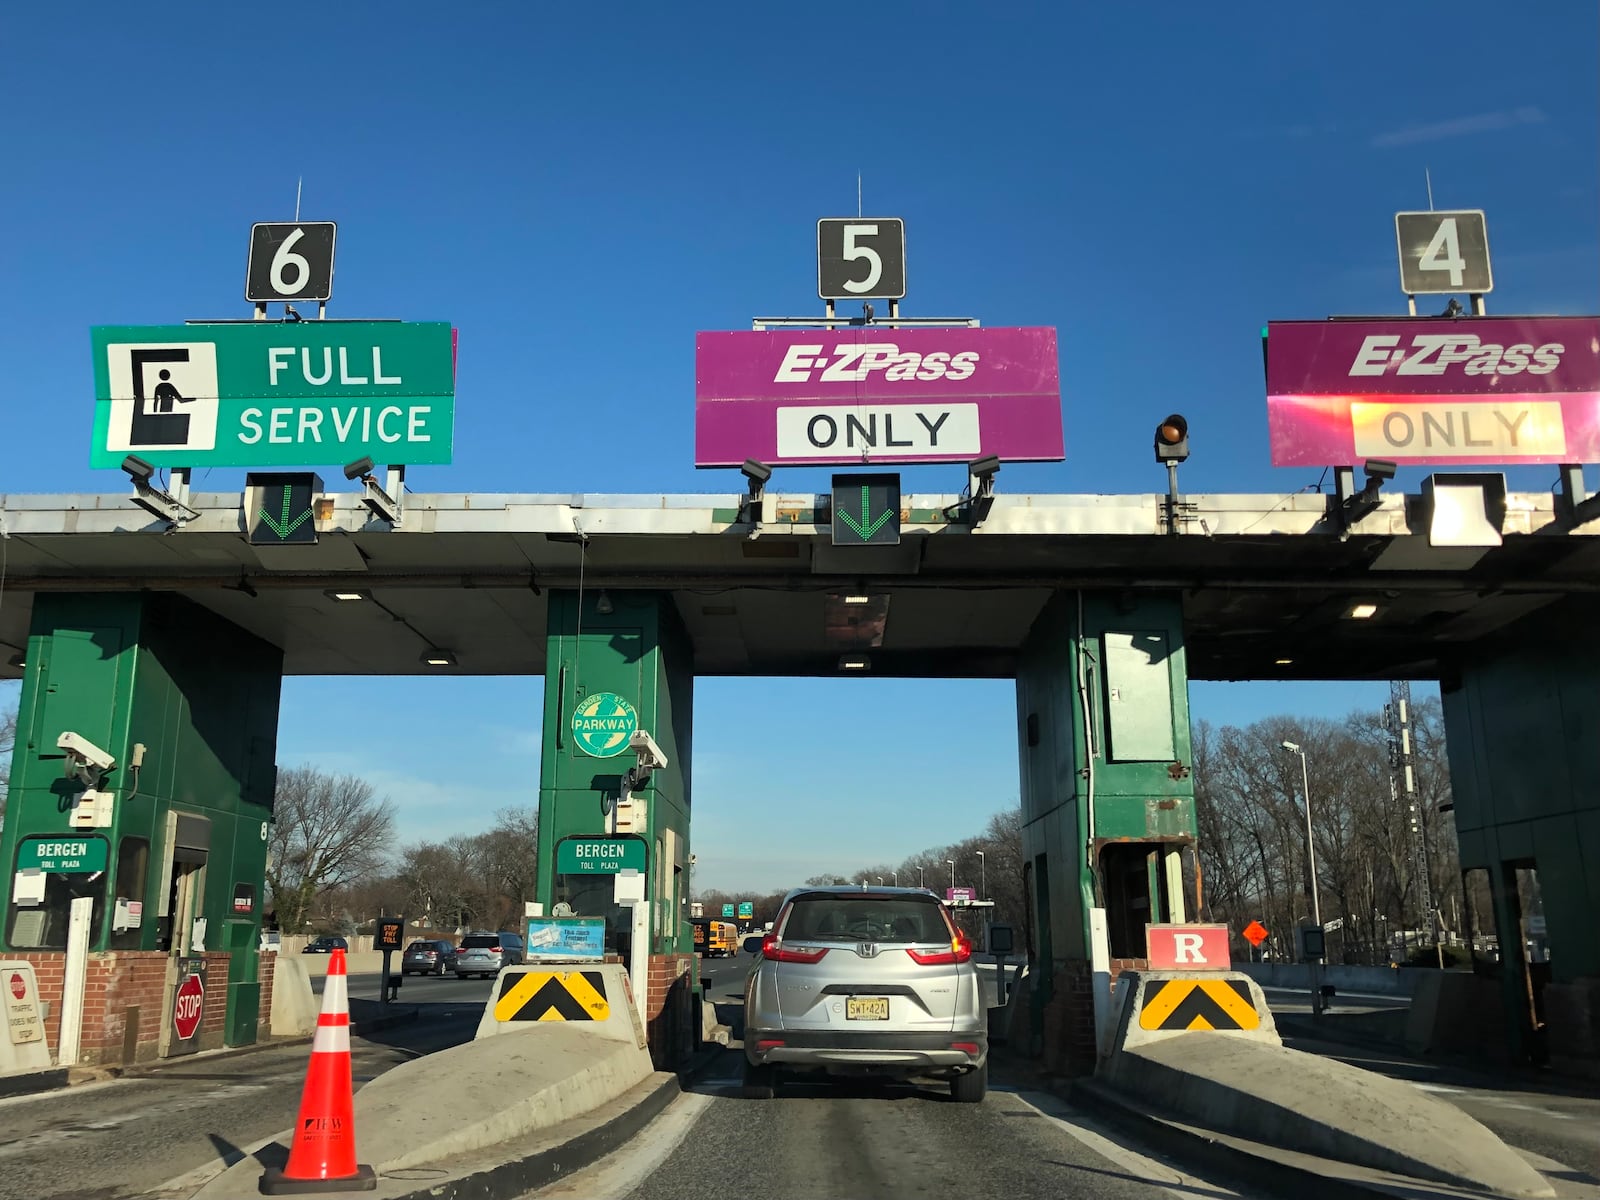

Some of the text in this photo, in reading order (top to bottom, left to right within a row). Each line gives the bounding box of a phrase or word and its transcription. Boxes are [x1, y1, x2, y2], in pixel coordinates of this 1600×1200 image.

[270, 227, 310, 295] 6
[842, 224, 883, 293] 5
[1418, 217, 1466, 286] 4
[268, 346, 402, 385] FULL
[237, 406, 431, 444] SERVICE
[806, 412, 950, 448] ONLY
[1382, 410, 1529, 447] ONLY
[577, 695, 633, 715] GARDEN STATE
[575, 719, 633, 730] PARKWAY
[37, 843, 87, 857] BERGEN
[61, 860, 80, 868] PLAZA
[576, 844, 624, 858] BERGEN
[1173, 933, 1208, 963] R
[177, 994, 201, 1019] STOP
